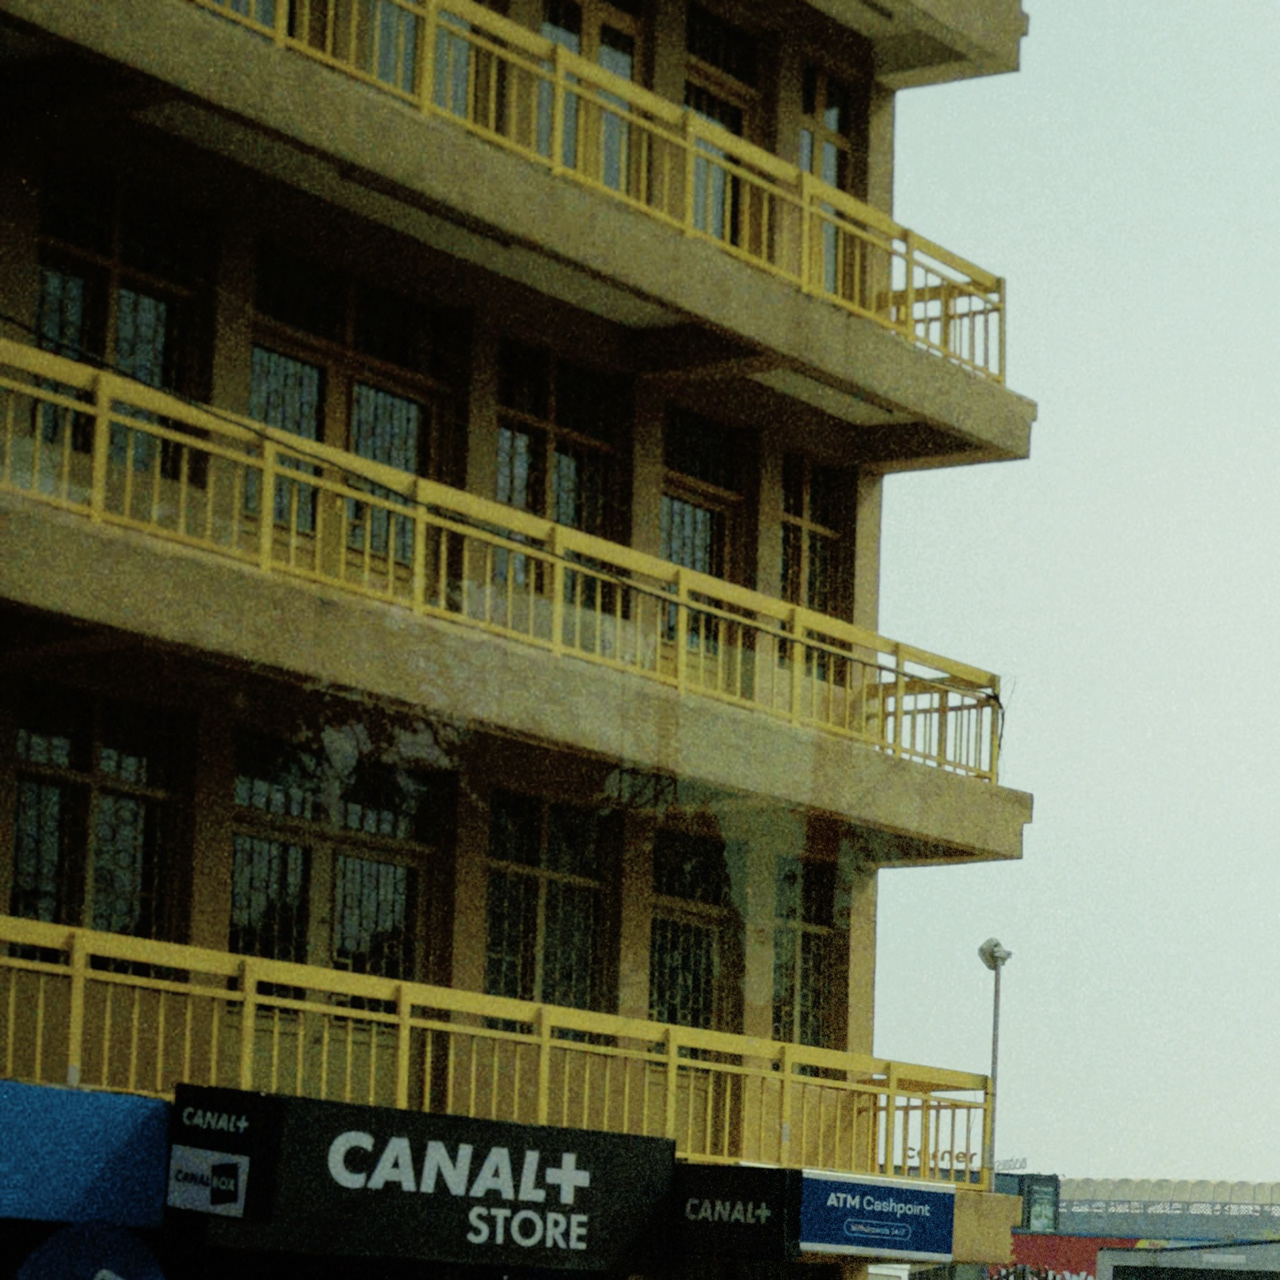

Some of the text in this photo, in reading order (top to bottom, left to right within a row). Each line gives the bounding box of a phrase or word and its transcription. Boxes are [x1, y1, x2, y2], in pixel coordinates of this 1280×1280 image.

[182, 1106, 250, 1133] CANAL+
[327, 1130, 591, 1205] CANAL+
[685, 1198, 771, 1225] CANAL+
[826, 1191, 931, 1218] ATM Cashpoint
[467, 1208, 588, 1250] STORE
